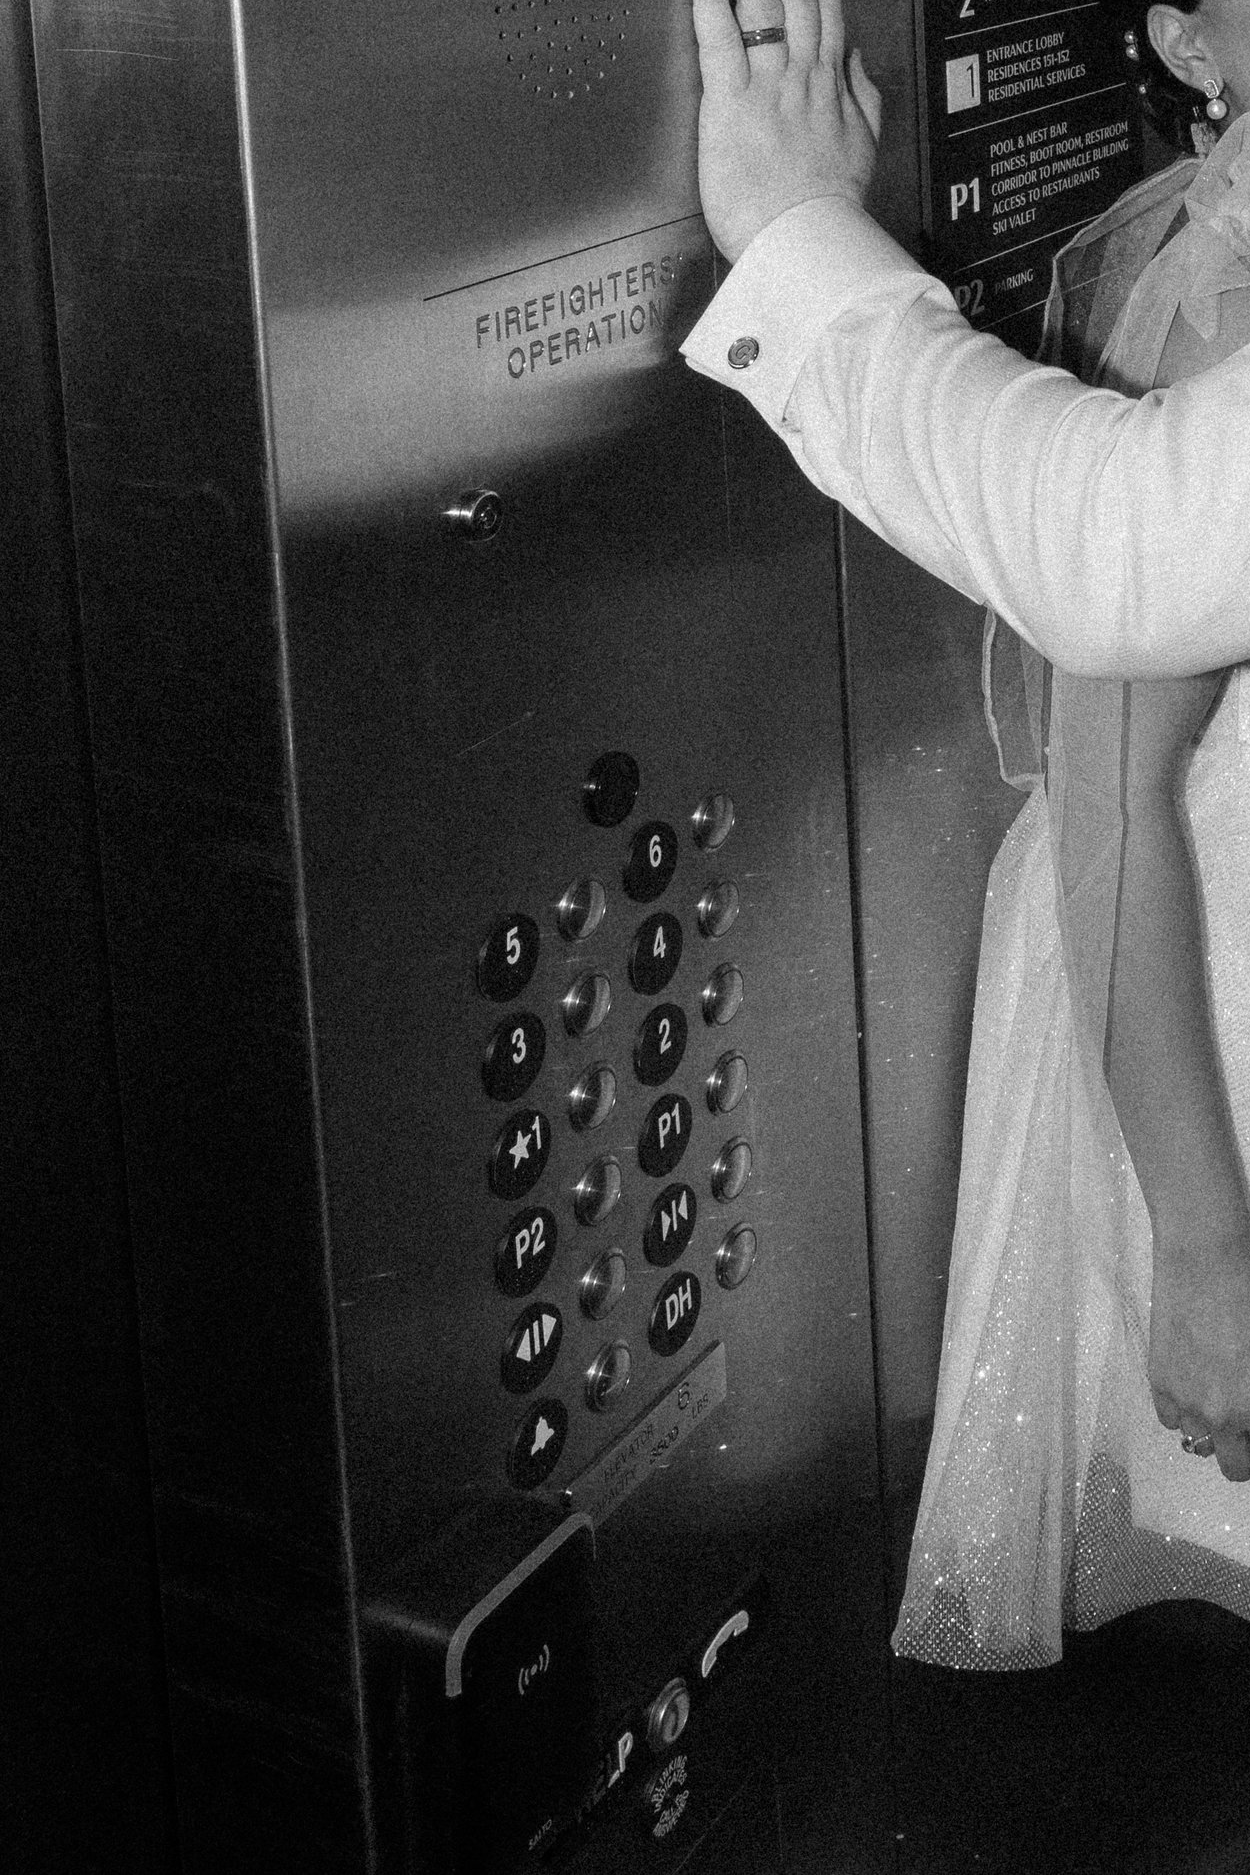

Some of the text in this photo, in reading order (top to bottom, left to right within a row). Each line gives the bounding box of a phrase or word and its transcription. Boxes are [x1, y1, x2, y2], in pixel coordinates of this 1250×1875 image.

[987, 32, 1065, 64] ENTRANCE LOBBY
[987, 49, 1070, 83] RESIDENCES 151-152
[966, 63, 976, 99] 1
[988, 64, 1086, 103] RESIDENTIAL SERVICES
[990, 121, 1068, 158] POOL & NEST BAR
[991, 121, 1129, 177] FITNESS, BOOT ROOM, RESTROOM
[991, 138, 1129, 197] CORRIDOR TO PINNACLE BUILDING
[950, 177, 980, 221] P1
[992, 166, 1101, 217] ACCESS TO RESTAURANTS
[992, 208, 1037, 236] SKI VALET
[954, 279, 986, 316] P2
[994, 268, 1034, 295] PARKING
[506, 299, 666, 379] OPERATION
[648, 834, 662, 868] 6
[506, 926, 521, 965] 5
[653, 925, 667, 960] 4
[511, 1027, 527, 1064] 3
[658, 1018, 672, 1054] 2
[658, 1102, 682, 1149] P1
[515, 1217, 546, 1269] P2
[665, 1278, 692, 1331] DH
[677, 1381, 691, 1411] 6
[691, 1392, 709, 1420] LBS
